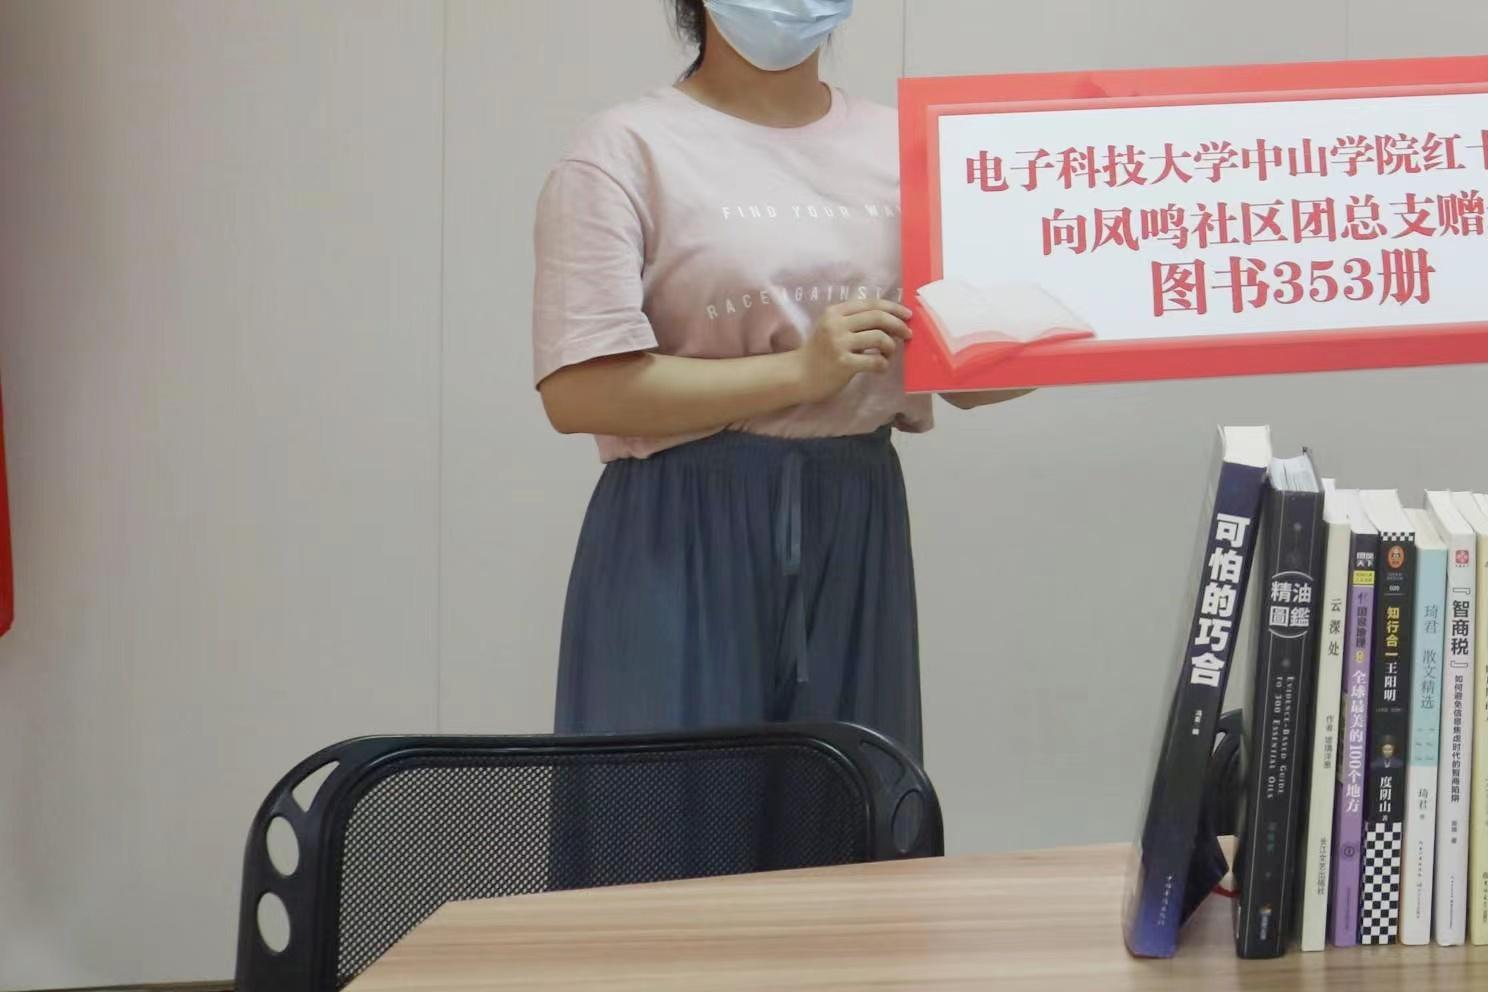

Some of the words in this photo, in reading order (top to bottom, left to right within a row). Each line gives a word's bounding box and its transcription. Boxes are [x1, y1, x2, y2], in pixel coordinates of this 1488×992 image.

[722, 204, 777, 220] FIND
[792, 205, 850, 219] YOUR
[1150, 248, 1437, 317] 图书353册
[707, 289, 770, 320] RACE
[1190, 513, 1251, 687] 可怕的巧合
[1270, 581, 1312, 603] 精油
[1268, 605, 1311, 628] 圖鑑
[1328, 598, 1342, 657] 云深处
[1423, 605, 1439, 634] 琦君
[1420, 650, 1437, 709] 散文精选
[1346, 669, 1366, 812] 全球最美的100个地方
[1379, 776, 1392, 813] 度阴山
